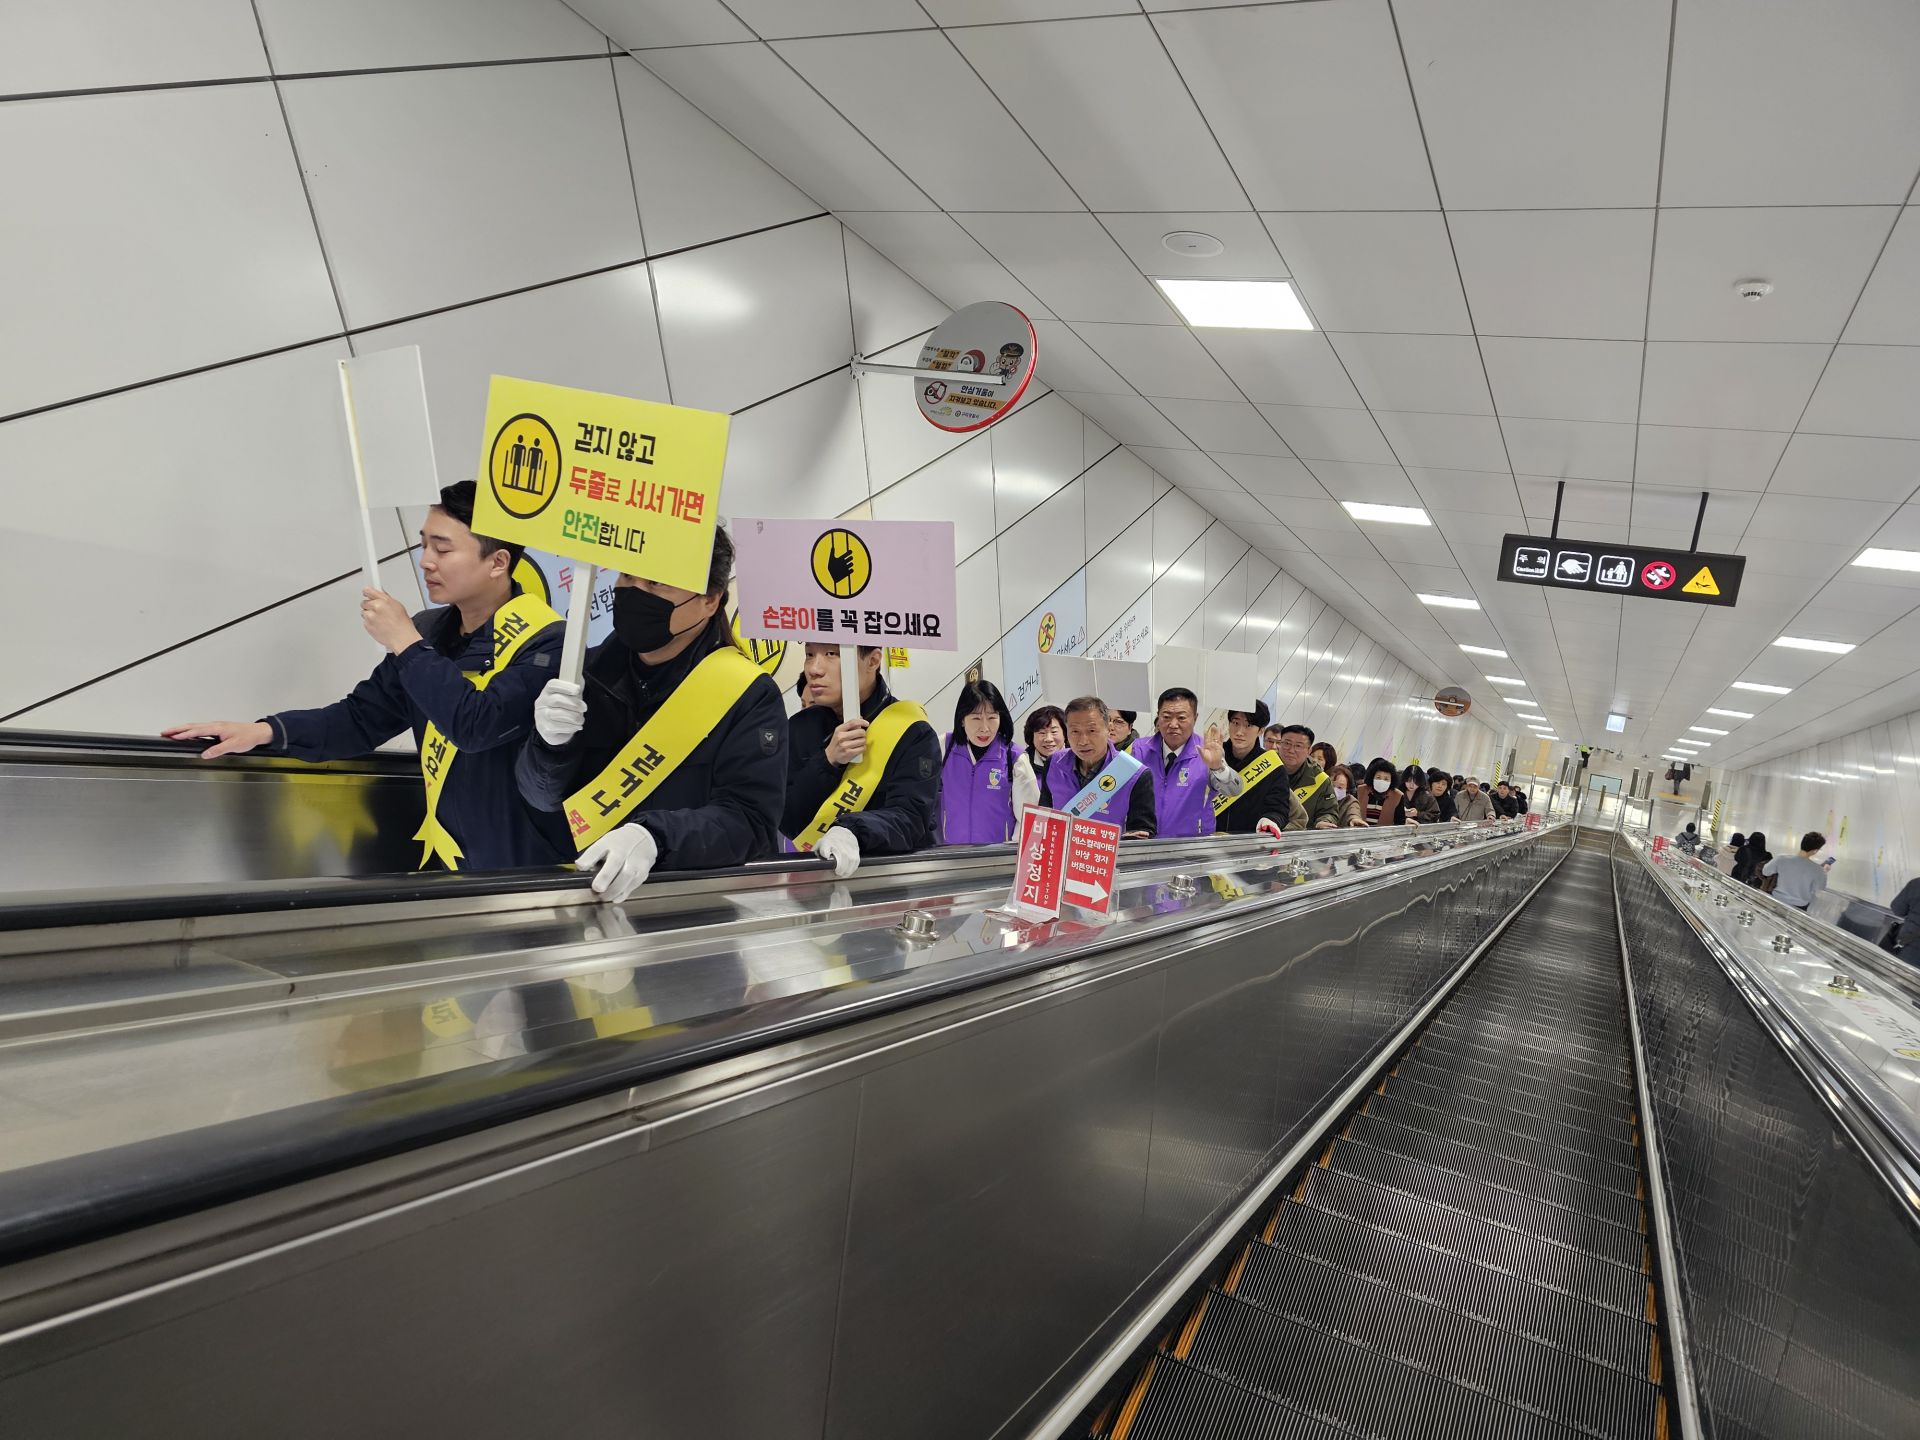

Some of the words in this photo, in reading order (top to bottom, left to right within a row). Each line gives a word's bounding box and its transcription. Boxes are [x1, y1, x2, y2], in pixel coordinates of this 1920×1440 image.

[574, 421, 613, 456] 걷지
[616, 430, 656, 465] 않고
[568, 465, 622, 503] 두줄로
[625, 478, 705, 524] 서서가면
[561, 508, 646, 554] 안전합니다
[494, 611, 530, 660] 걷거
[762, 605, 834, 632] 손잡이를
[840, 609, 859, 633] 꼭
[864, 610, 942, 638] 잡으세요
[424, 735, 451, 781] 세요
[591, 743, 666, 817] 걷거나
[1243, 758, 1272, 784] 걷거나
[1047, 824, 1058, 879] EMERGENCY
[1071, 835, 1115, 853] 에스컬레이터
[1074, 823, 1097, 836] 화살표
[1100, 829, 1116, 840] 방향
[1075, 849, 1091, 860] 비상
[1094, 852, 1109, 865] 정지
